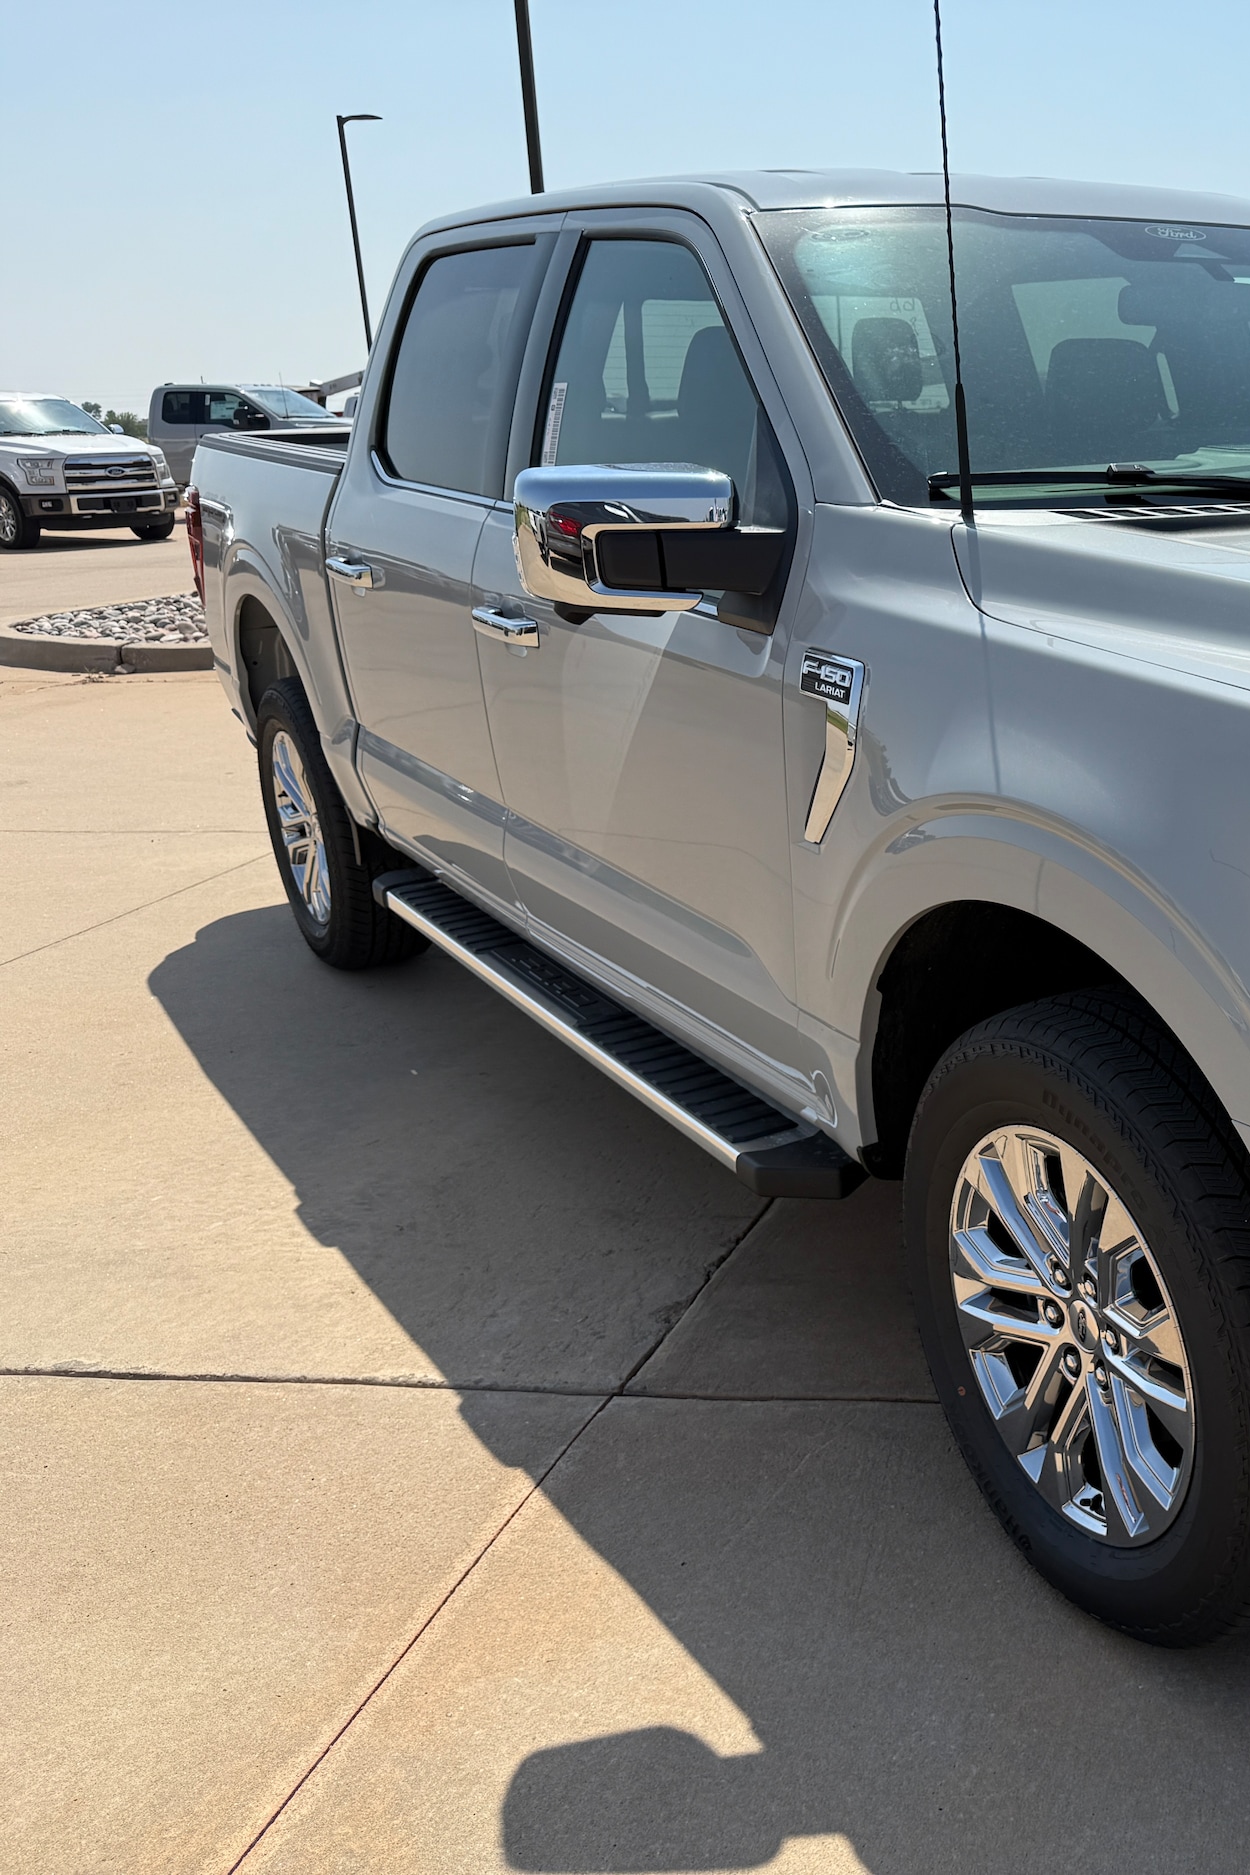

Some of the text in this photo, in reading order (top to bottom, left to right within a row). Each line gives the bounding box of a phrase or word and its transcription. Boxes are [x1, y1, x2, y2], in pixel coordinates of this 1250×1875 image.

[1157, 227, 1197, 239] Ford
[802, 660, 852, 688] F-150
[815, 681, 846, 699] LARIAT
